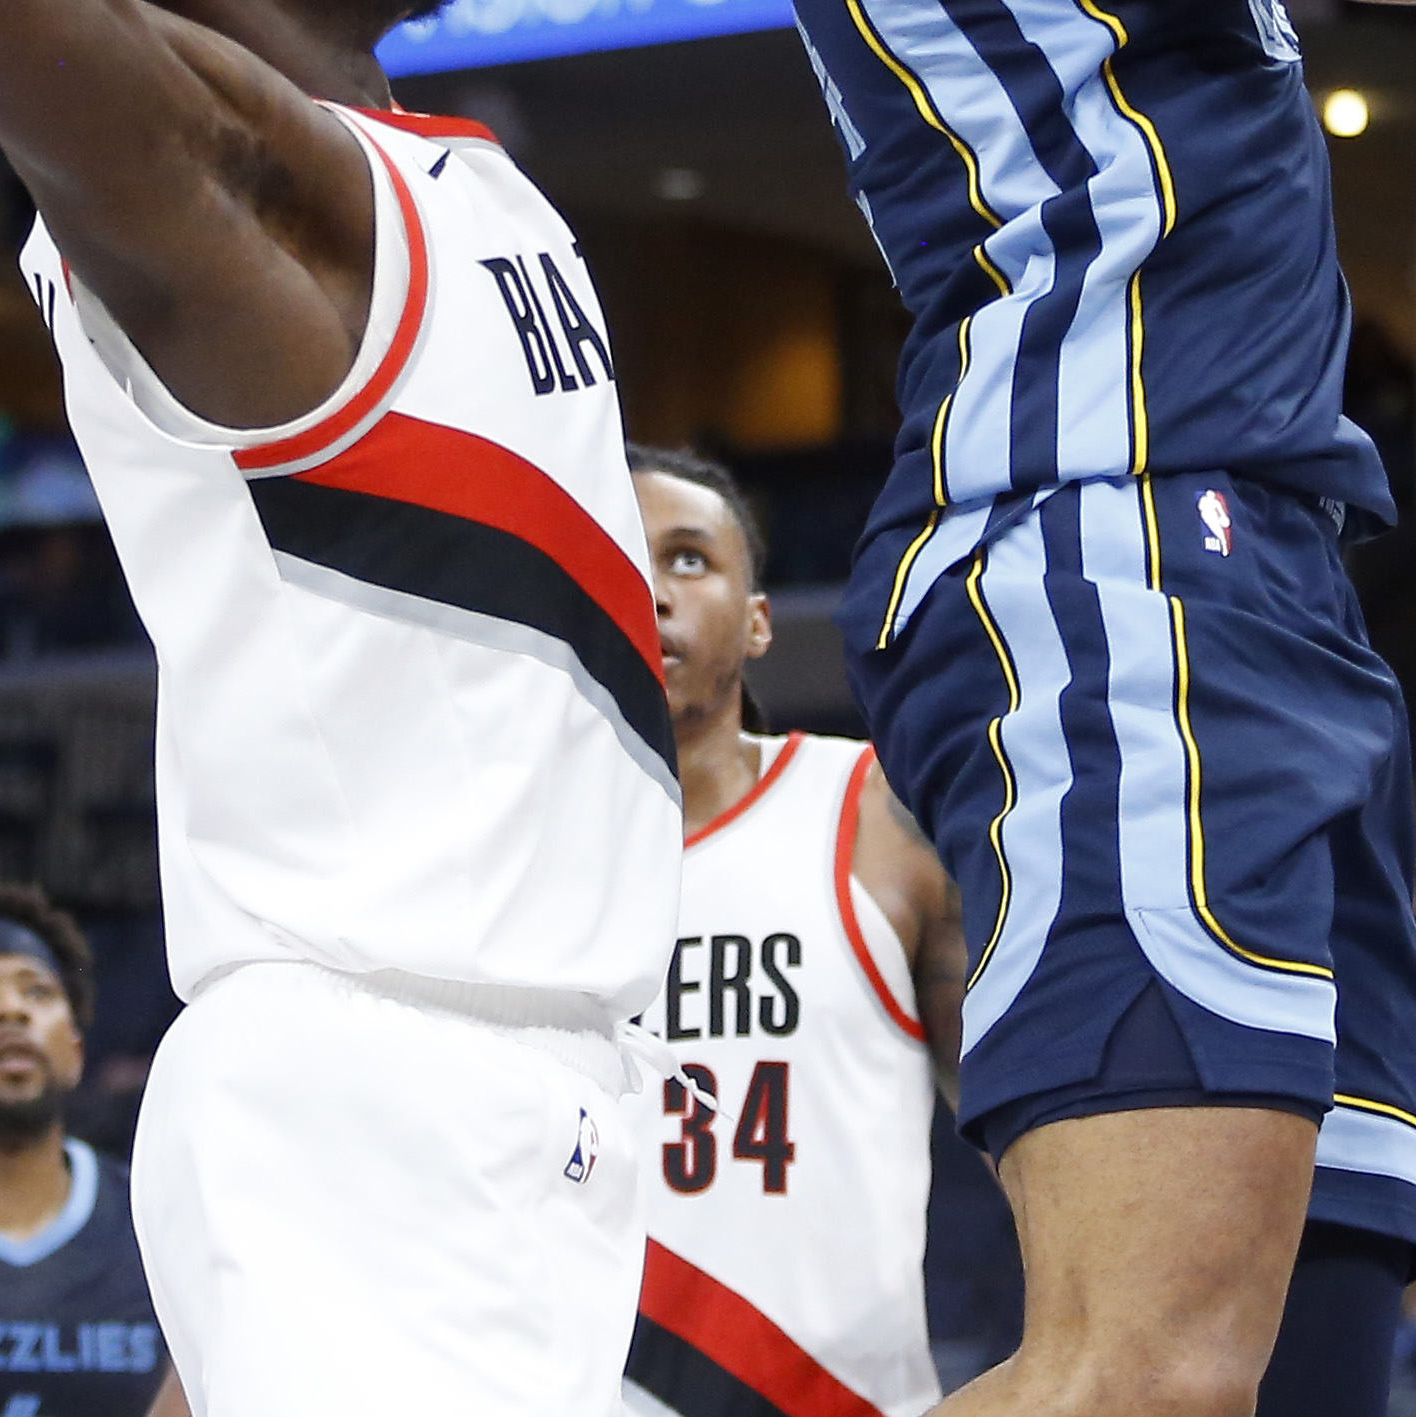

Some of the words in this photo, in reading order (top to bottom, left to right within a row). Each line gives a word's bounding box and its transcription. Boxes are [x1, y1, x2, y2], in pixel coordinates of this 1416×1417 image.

[477, 241, 616, 397] BLA
[629, 931, 802, 1043] ERS
[662, 1061, 796, 1195] 34
